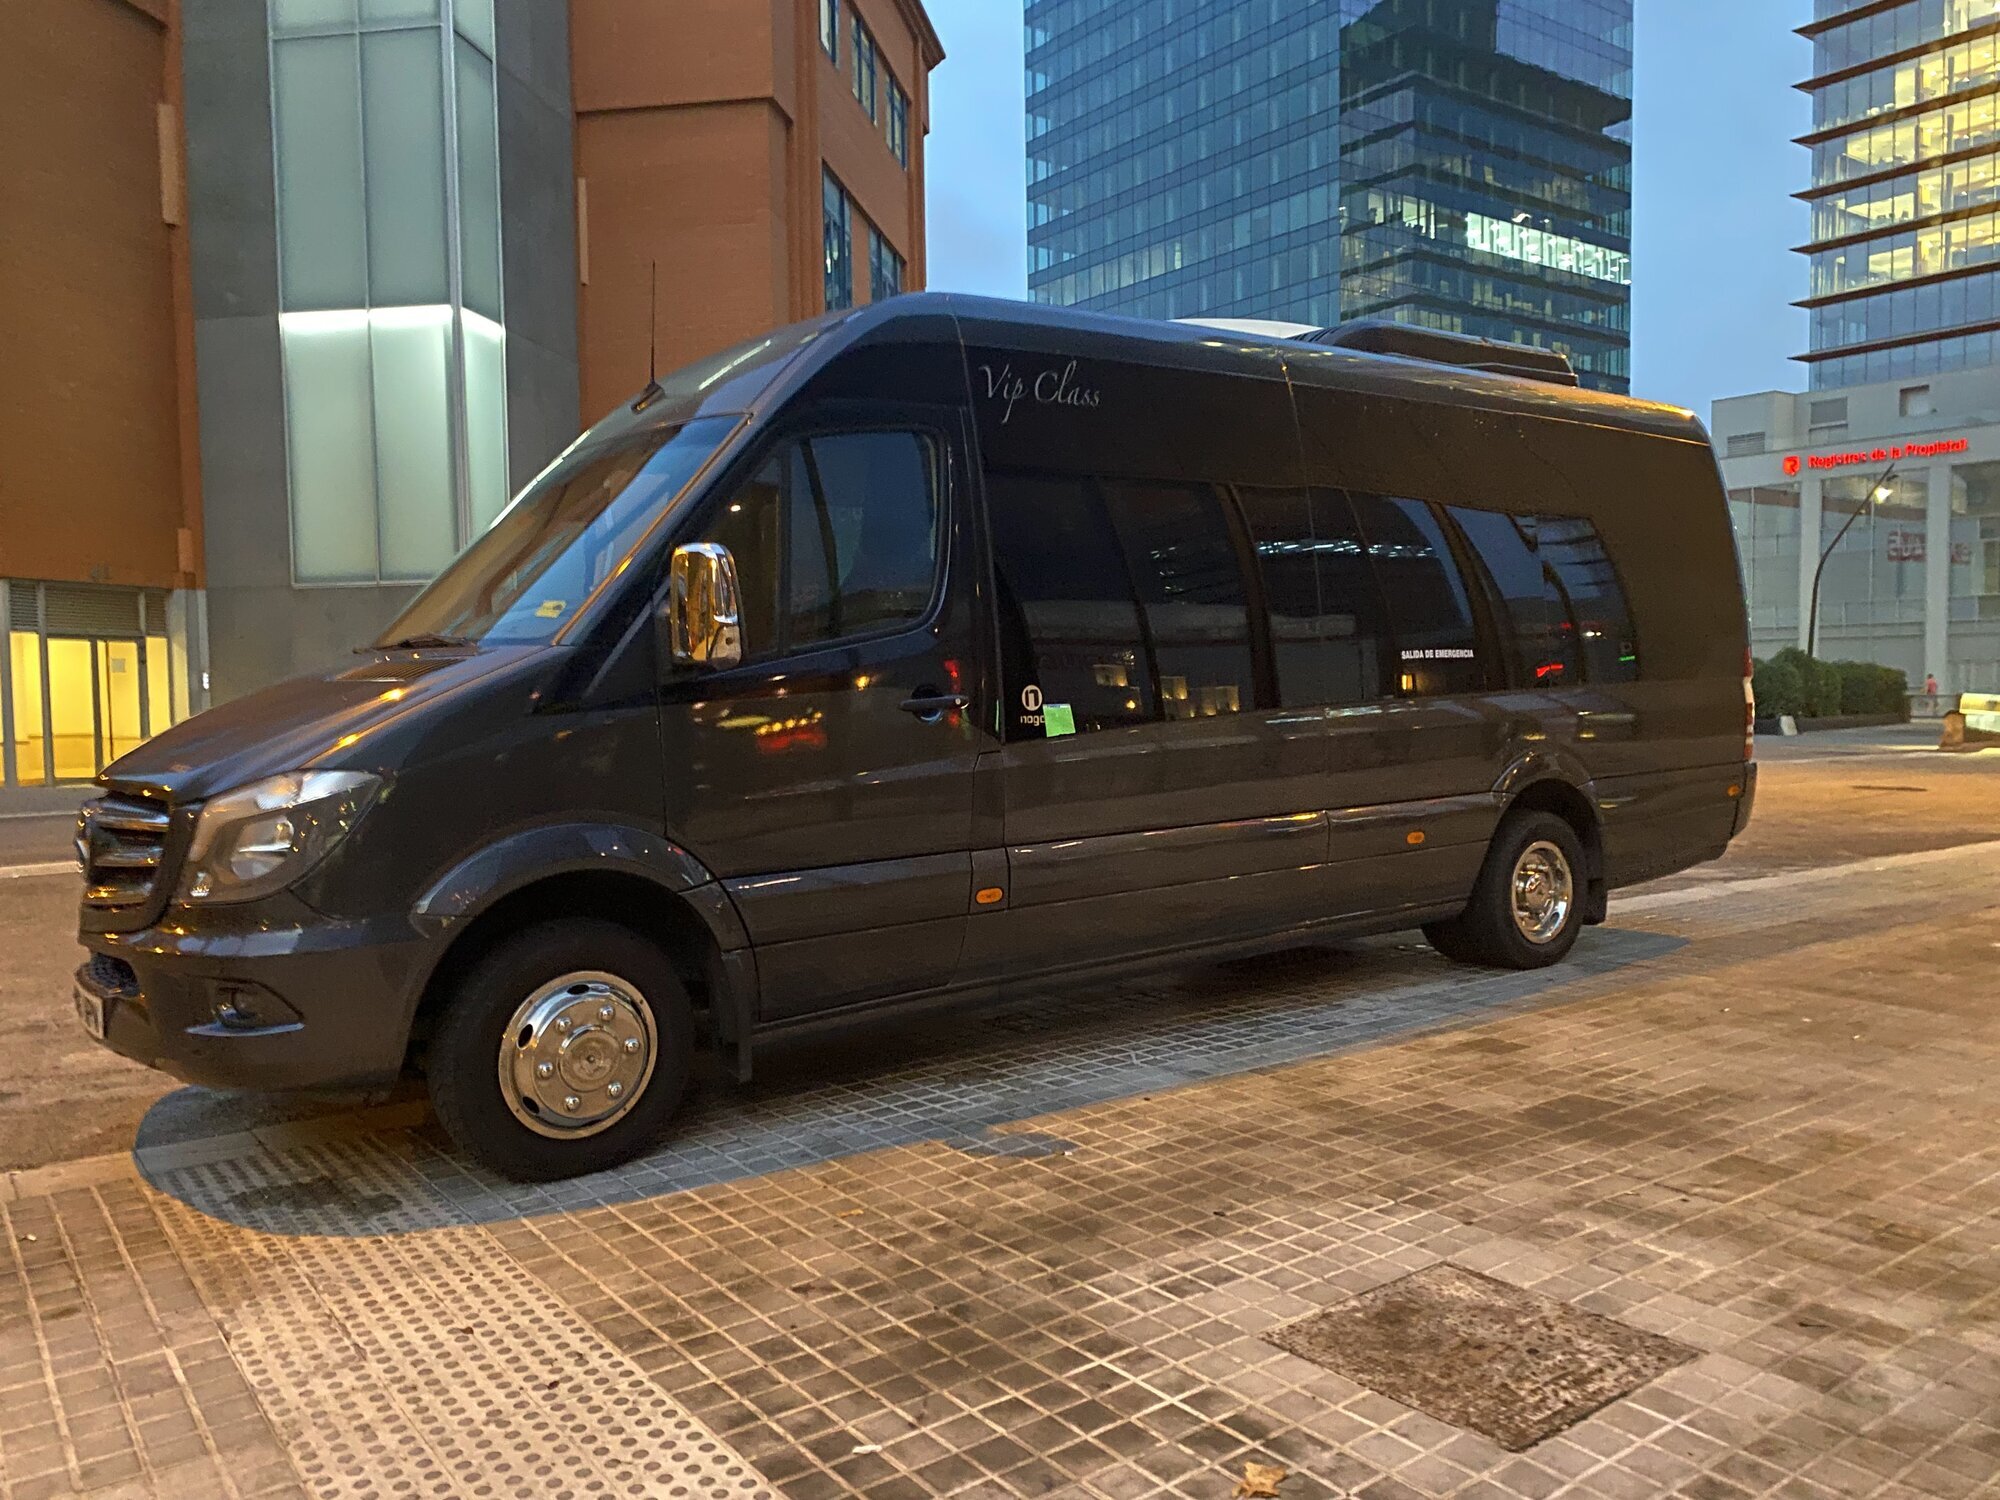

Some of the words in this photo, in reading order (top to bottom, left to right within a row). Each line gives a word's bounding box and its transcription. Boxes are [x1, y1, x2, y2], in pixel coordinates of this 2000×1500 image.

[978, 363, 1028, 424] Vip
[1034, 359, 1101, 408] Class
[1808, 451, 1867, 469] Registres
[1869, 447, 1887, 461] de
[1890, 446, 1901, 460] la
[1904, 437, 1968, 457] Propietat
[1401, 649, 1424, 660] SALIDA
[1425, 649, 1434, 659] DE
[1435, 649, 1475, 659] EMERGENCIA
